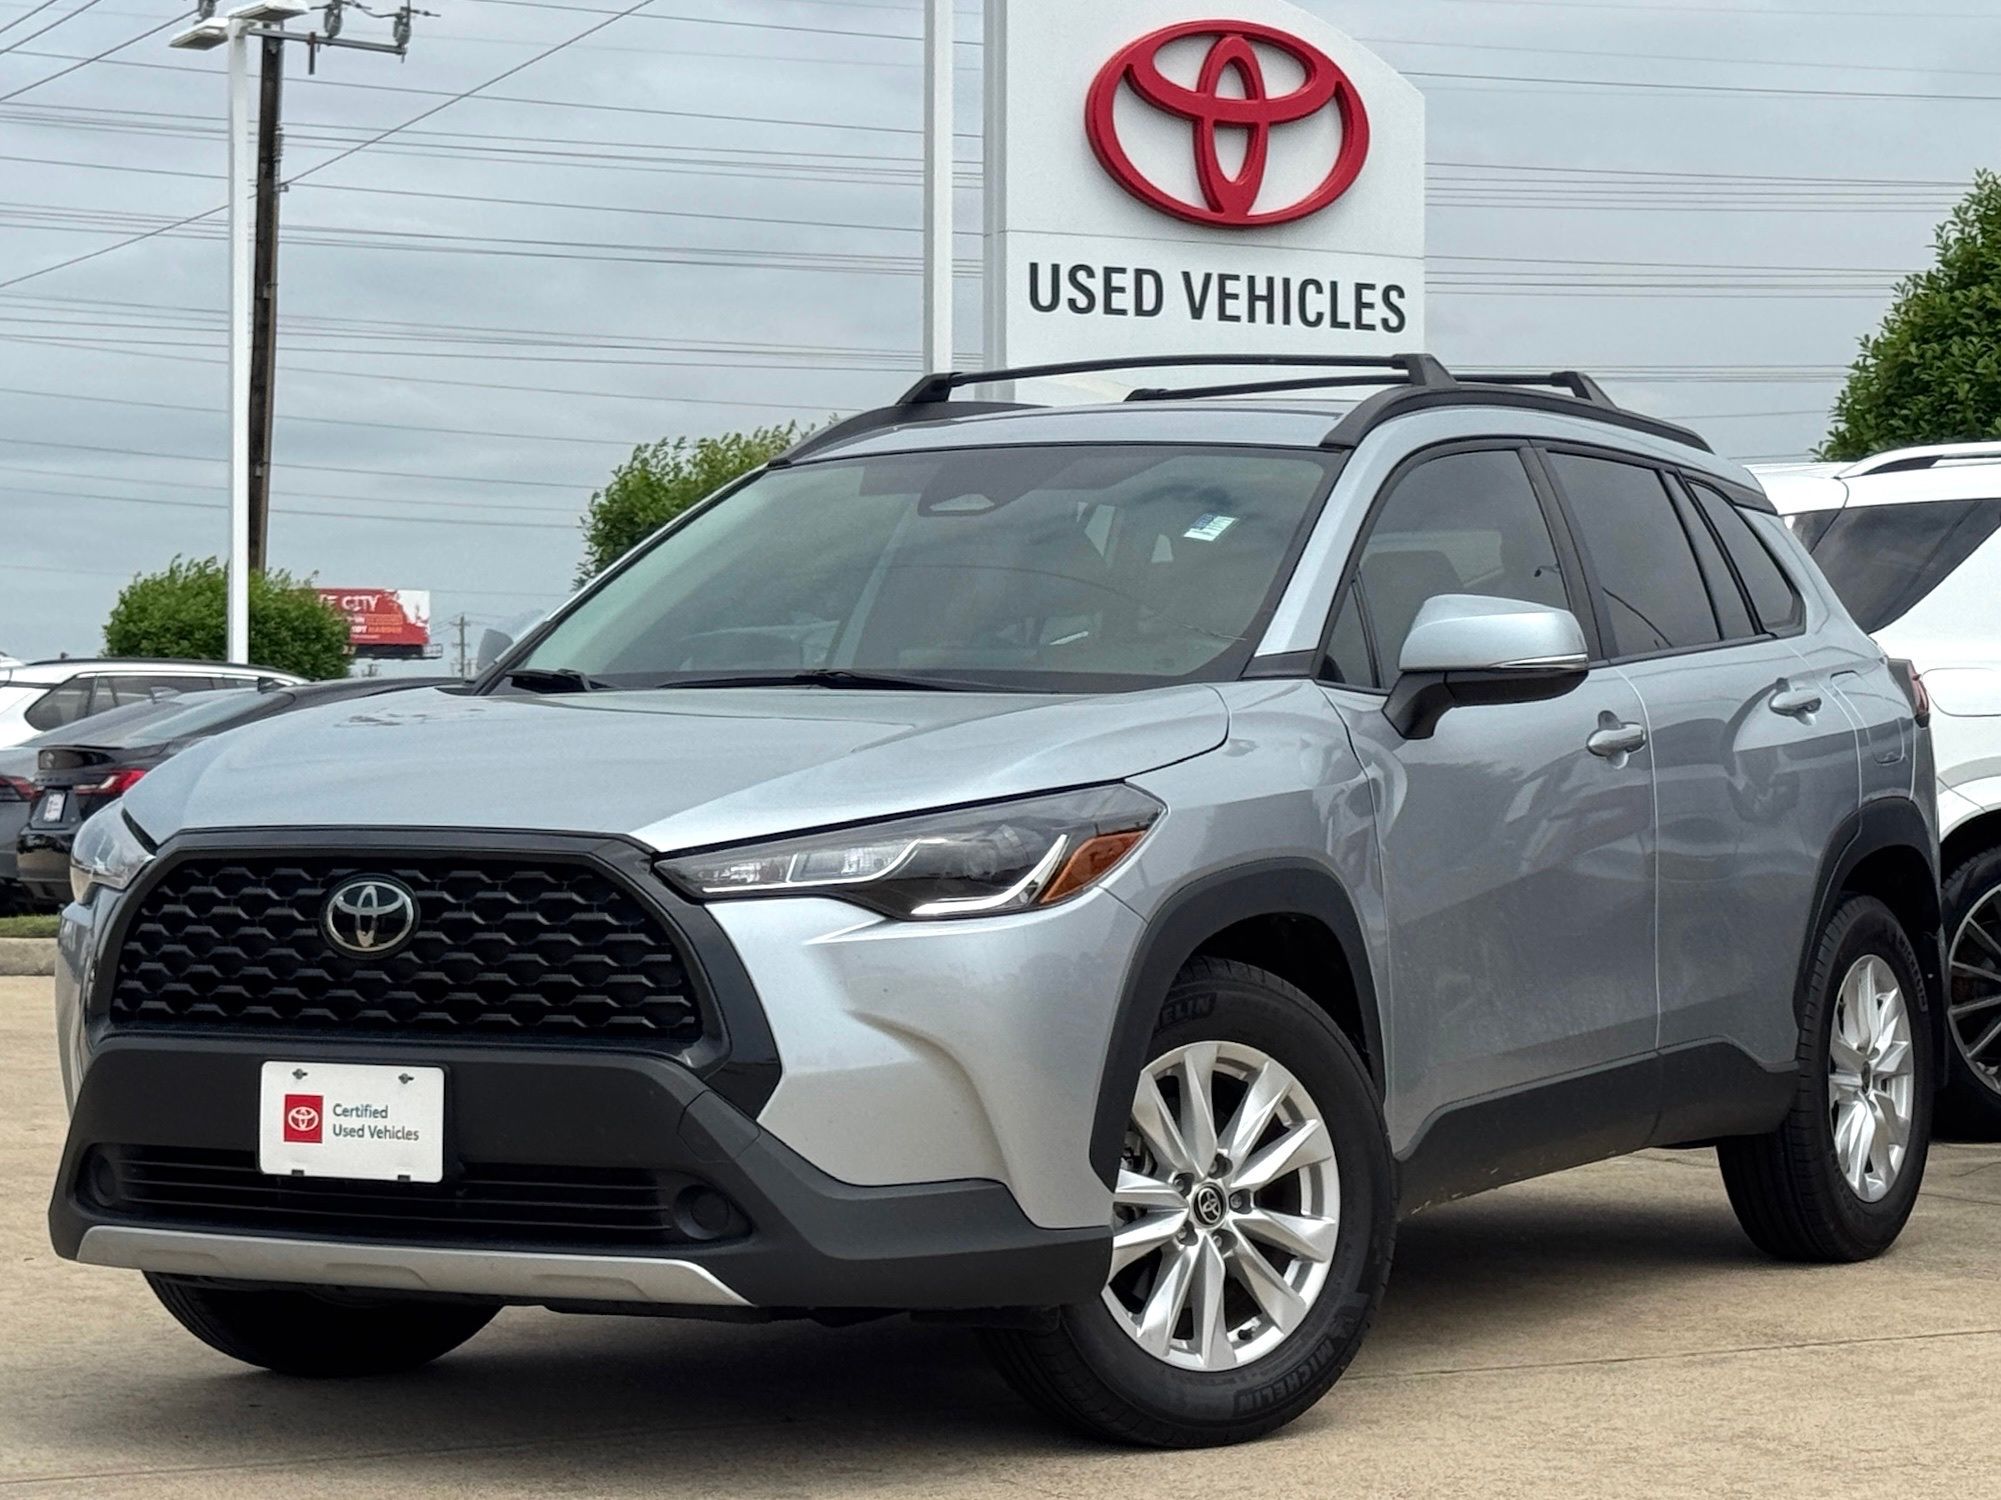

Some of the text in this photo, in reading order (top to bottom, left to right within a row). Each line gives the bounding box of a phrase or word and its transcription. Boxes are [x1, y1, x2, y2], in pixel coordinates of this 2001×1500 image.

[1029, 262, 1406, 333] USED VEHICLES
[333, 1103, 388, 1119] Certified
[333, 1124, 419, 1141] Used Vehicles
[1238, 1338, 1337, 1411] MICHELIN
